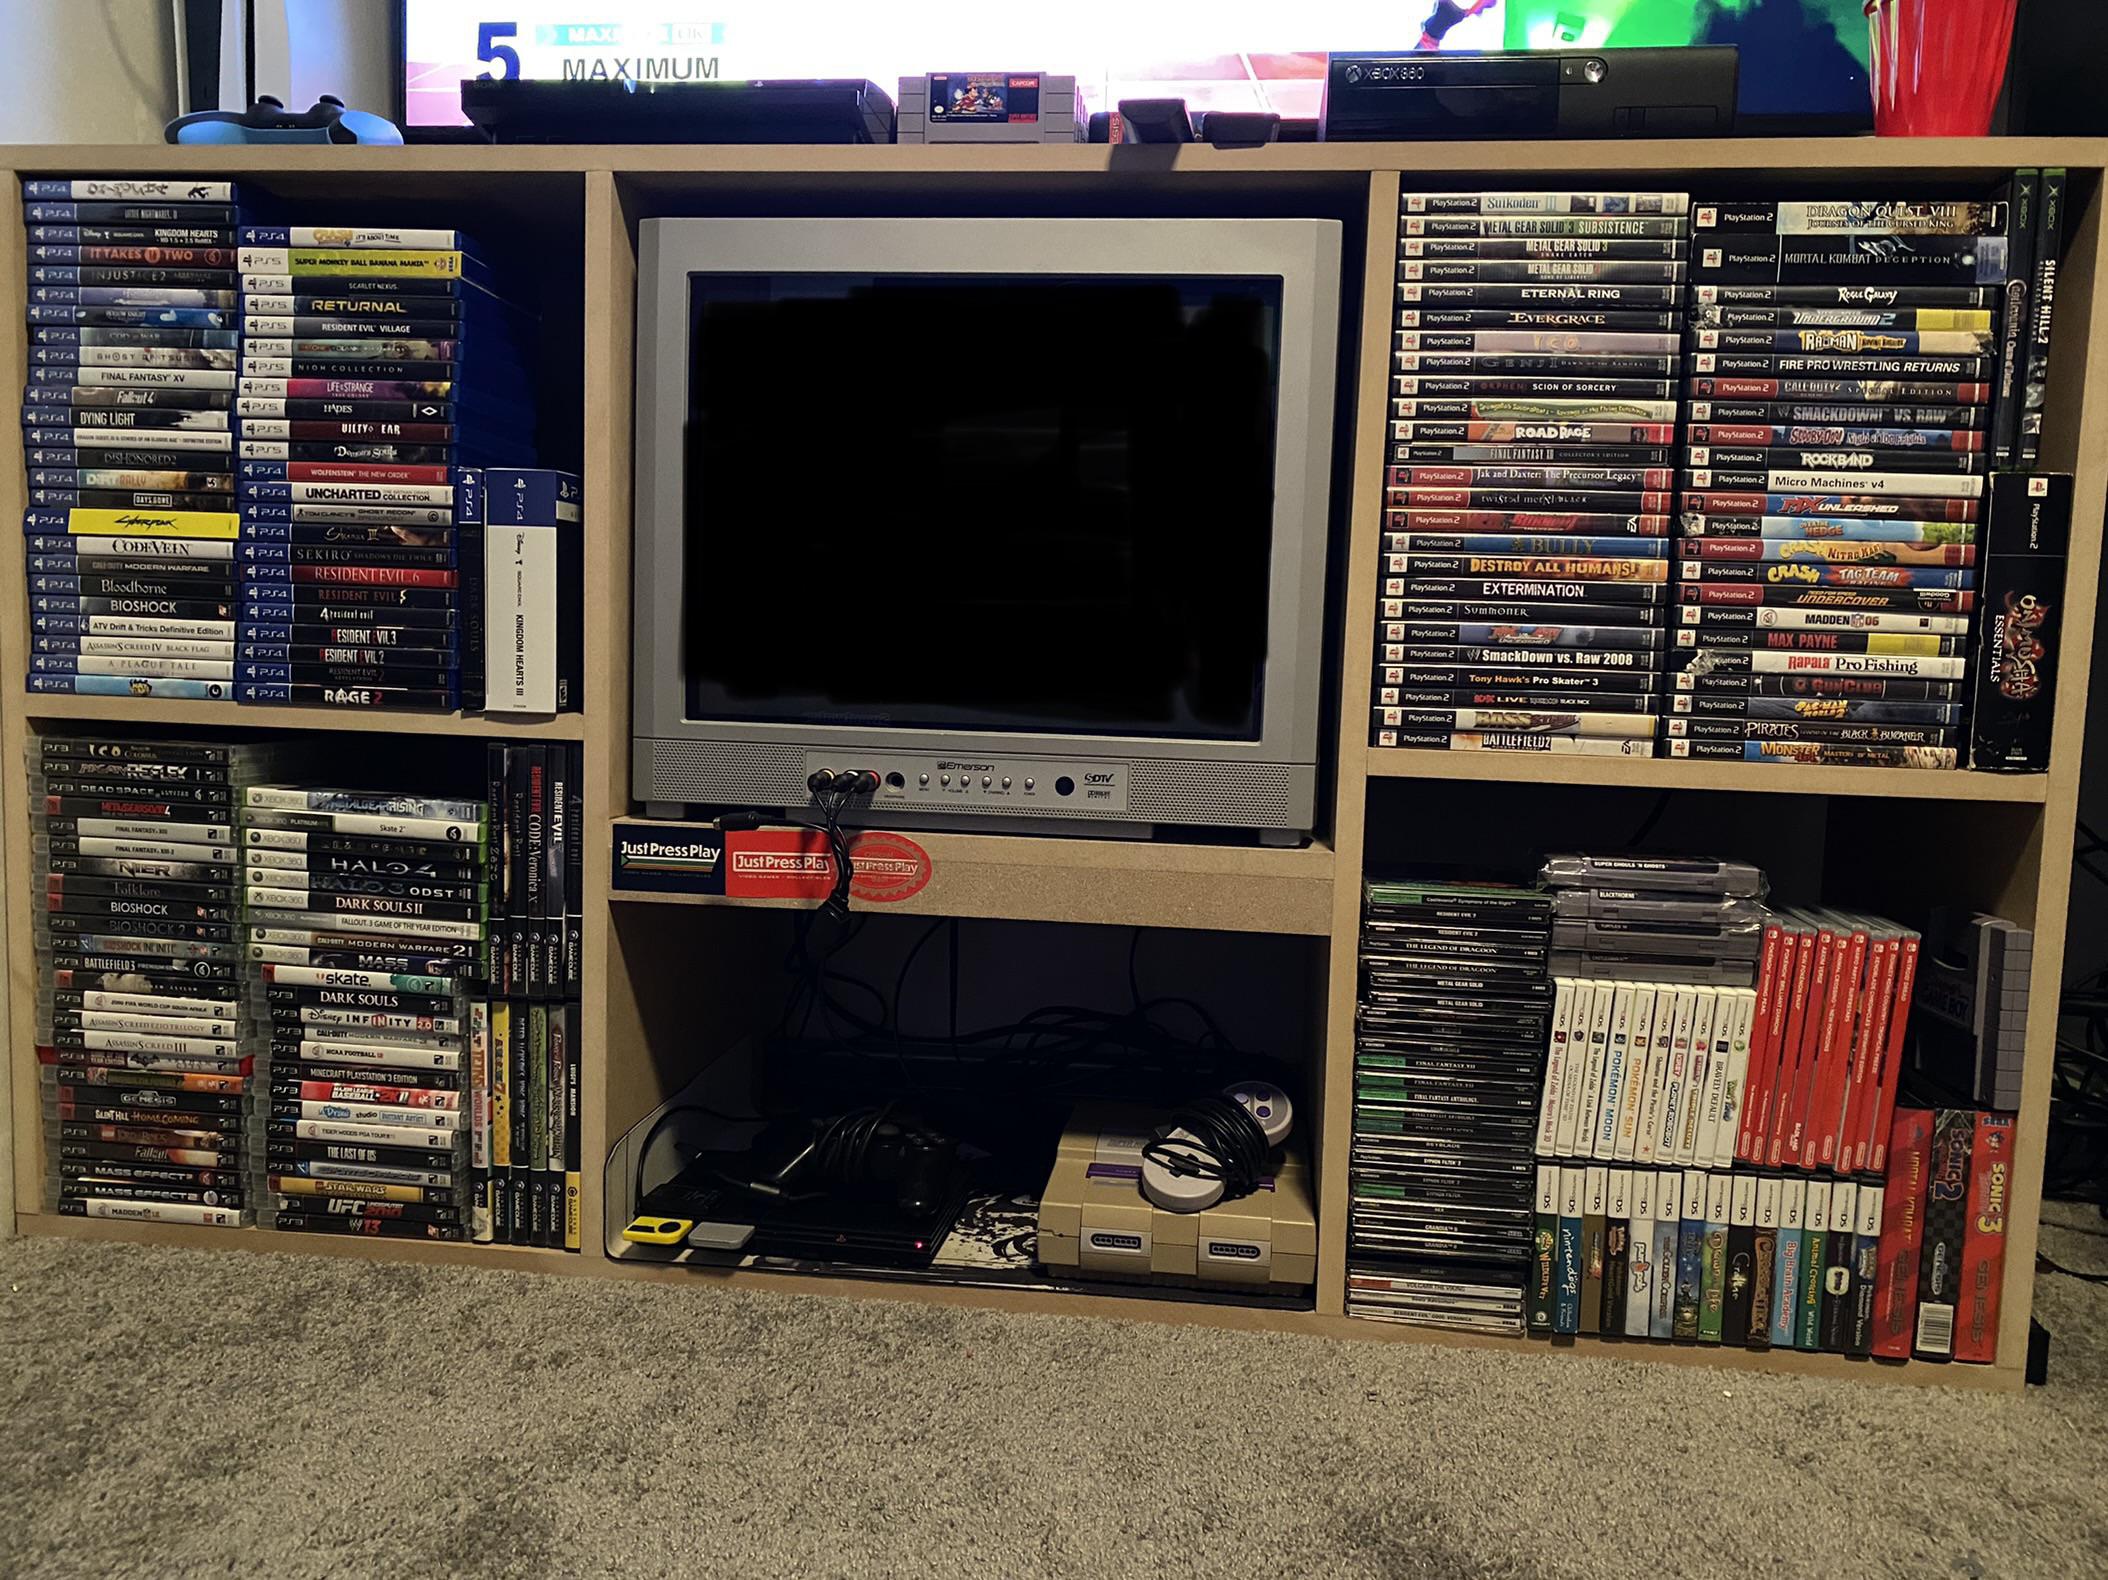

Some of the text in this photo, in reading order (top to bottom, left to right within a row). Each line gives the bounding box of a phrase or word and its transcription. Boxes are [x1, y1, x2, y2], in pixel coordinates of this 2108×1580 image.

[476, 22, 520, 80] 5
[562, 57, 719, 80] MAXIMUM
[1363, 67, 1424, 80] XBOX 360
[1724, 213, 1773, 222] PlayStation 2
[1807, 205, 1957, 218] DRAGON QUEST VIII
[1432, 223, 1470, 231] PlayStation
[1484, 221, 1645, 234] METAL GEAR SOLID 3 SUBSISTENCE
[319, 258, 349, 266] MONKEY
[1785, 254, 1950, 265] MORTAL KOMBAT DECEPTION
[2042, 260, 2056, 301] SILENT
[1521, 289, 1620, 299] ETERNAL RING
[312, 300, 407, 313] RETURNAL
[2038, 305, 2053, 334] HILL
[322, 324, 410, 333] RESIDENT EVIL VILLAGE
[1779, 360, 1960, 373] FIRE PRO WRESTLING RETURNS
[101, 373, 185, 382] FINAL FANTASY XV
[1532, 383, 1558, 391] SCION
[1576, 383, 1617, 392] SORCERY
[117, 391, 154, 404] Fallout 4
[80, 412, 136, 426] DYING LIGHT
[1476, 469, 1637, 483] Jak and Daxter: The Precursor Legacy
[1776, 477, 1884, 489] Micro Machines v4
[306, 487, 381, 500] UNCHARTED
[1818, 503, 1899, 514] UNLEASHED
[2030, 504, 2040, 542] PlayStation
[297, 550, 350, 561] SEKIRO
[1470, 559, 1637, 575] DESTROY ALL HUMANS!
[101, 579, 167, 595] Bloodborne
[1483, 582, 1584, 597] EXTERMINATION
[110, 600, 177, 613] BIOSHOCK
[1796, 594, 1890, 606] UNDERCOVER
[93, 622, 108, 630] ATV
[110, 622, 126, 631] Drift
[136, 624, 158, 632] Tricks
[160, 624, 195, 634] Definitive
[197, 626, 223, 635] Edition
[331, 629, 397, 645] RESIDENT EVIL 3
[1768, 632, 1838, 649] MAX PAYNE
[1990, 614, 2004, 682] ESSENTIALS
[516, 615, 524, 696] KINGDOM HEARTS III
[1482, 650, 1633, 665] SmackDown vs. Raw 2008
[1835, 658, 1918, 674] Pro Fishing
[1469, 674, 1598, 686] Tony Hawk's Pro Skater 3
[324, 688, 384, 704] RAGE 2
[947, 762, 994, 771] Emerson
[81, 784, 155, 795] DEAD SPACE
[621, 841, 720, 860] Just Press Play
[331, 857, 437, 878] HALO 4
[738, 856, 764, 868] Just
[766, 856, 802, 868] Press
[119, 862, 172, 877] NIER
[409, 887, 454, 898] ODST
[110, 902, 169, 916] BIOSHOCK
[348, 940, 468, 957] MODERN WARFARE 2
[1459, 945, 1497, 954] DRAGOON
[84, 958, 136, 970] BATTLEFIELD 3
[325, 972, 372, 987] skate.
[320, 991, 399, 1007] DARK SOULS
[346, 1014, 411, 1027] INFINITY
[417, 1021, 431, 1030] 2.0
[310, 1068, 345, 1078] MINECRAFT
[347, 1069, 387, 1082] PLAYSTATION
[393, 1074, 418, 1084] EDITION
[1714, 1061, 1724, 1093] BRAVELY
[1602, 1110, 1613, 1140] MOON
[1623, 1116, 1634, 1137] SUN
[325, 1183, 386, 1195] STAR WARS
[1976, 1163, 2006, 1234] SONIC 3
[112, 1208, 143, 1217] MADDEN
[327, 1198, 366, 1215] UFC
[1616, 1200, 1623, 1212] DS
[1811, 1238, 1820, 1269] Animal
[1561, 1229, 1578, 1296] nintendogs
[1778, 1240, 1797, 1329] Big Brain Academy
[1806, 1269, 1818, 1305] Crossing
